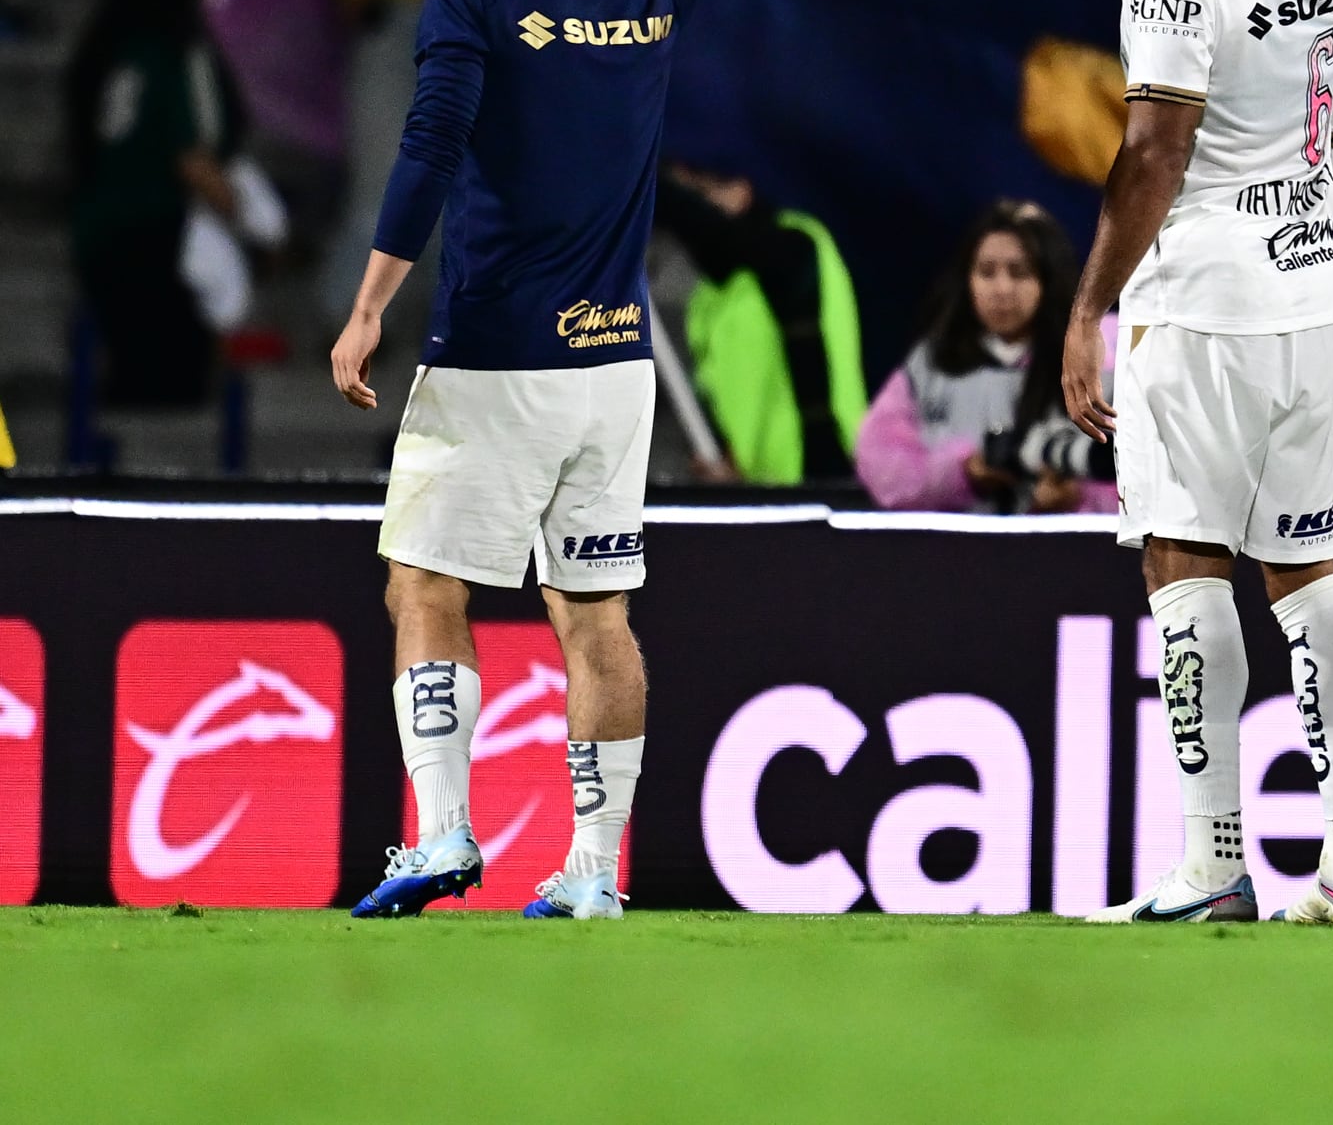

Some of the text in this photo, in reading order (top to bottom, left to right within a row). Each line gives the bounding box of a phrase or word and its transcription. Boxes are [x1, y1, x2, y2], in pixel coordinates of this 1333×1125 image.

[563, 14, 673, 46] SUZUKI
[1139, 26, 1199, 39] SEGUROS
[557, 298, 642, 337] Caliente
[568, 329, 640, 349] caliente.mx
[1162, 623, 1210, 775] CREST
